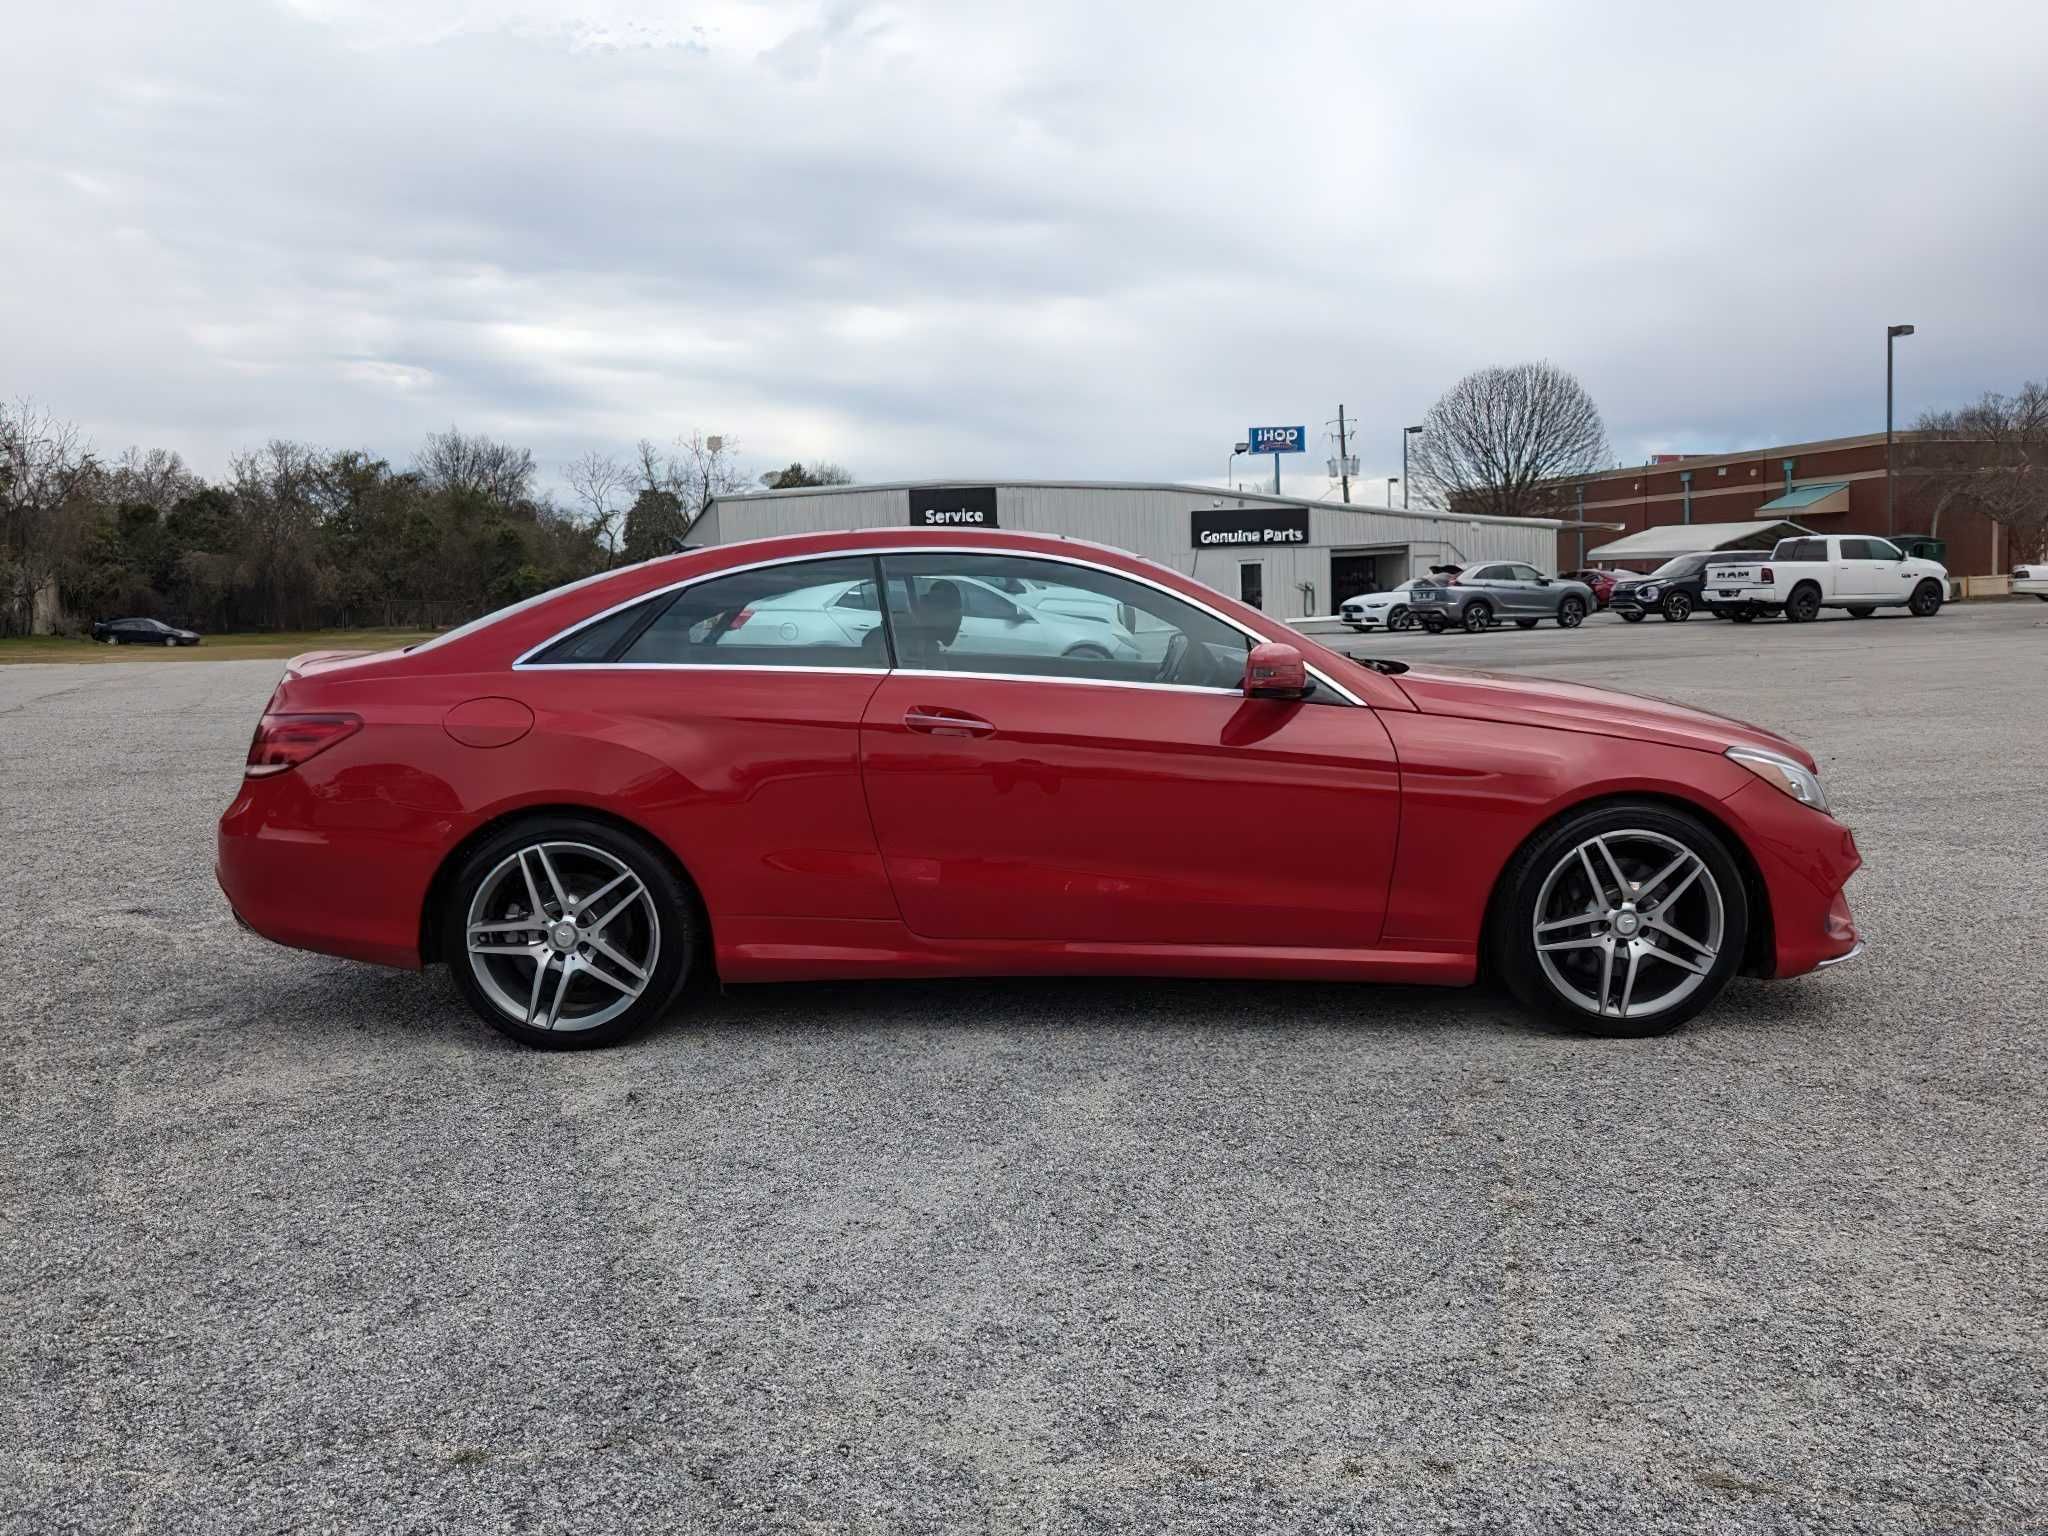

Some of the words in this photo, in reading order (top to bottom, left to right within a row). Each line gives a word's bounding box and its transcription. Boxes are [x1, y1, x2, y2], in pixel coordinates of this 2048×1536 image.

[1257, 429, 1298, 446] IHOP
[925, 507, 984, 524] Service
[1200, 530, 1260, 544] Genuine
[1263, 529, 1303, 542] Parts
[1716, 570, 1750, 579] RAM
